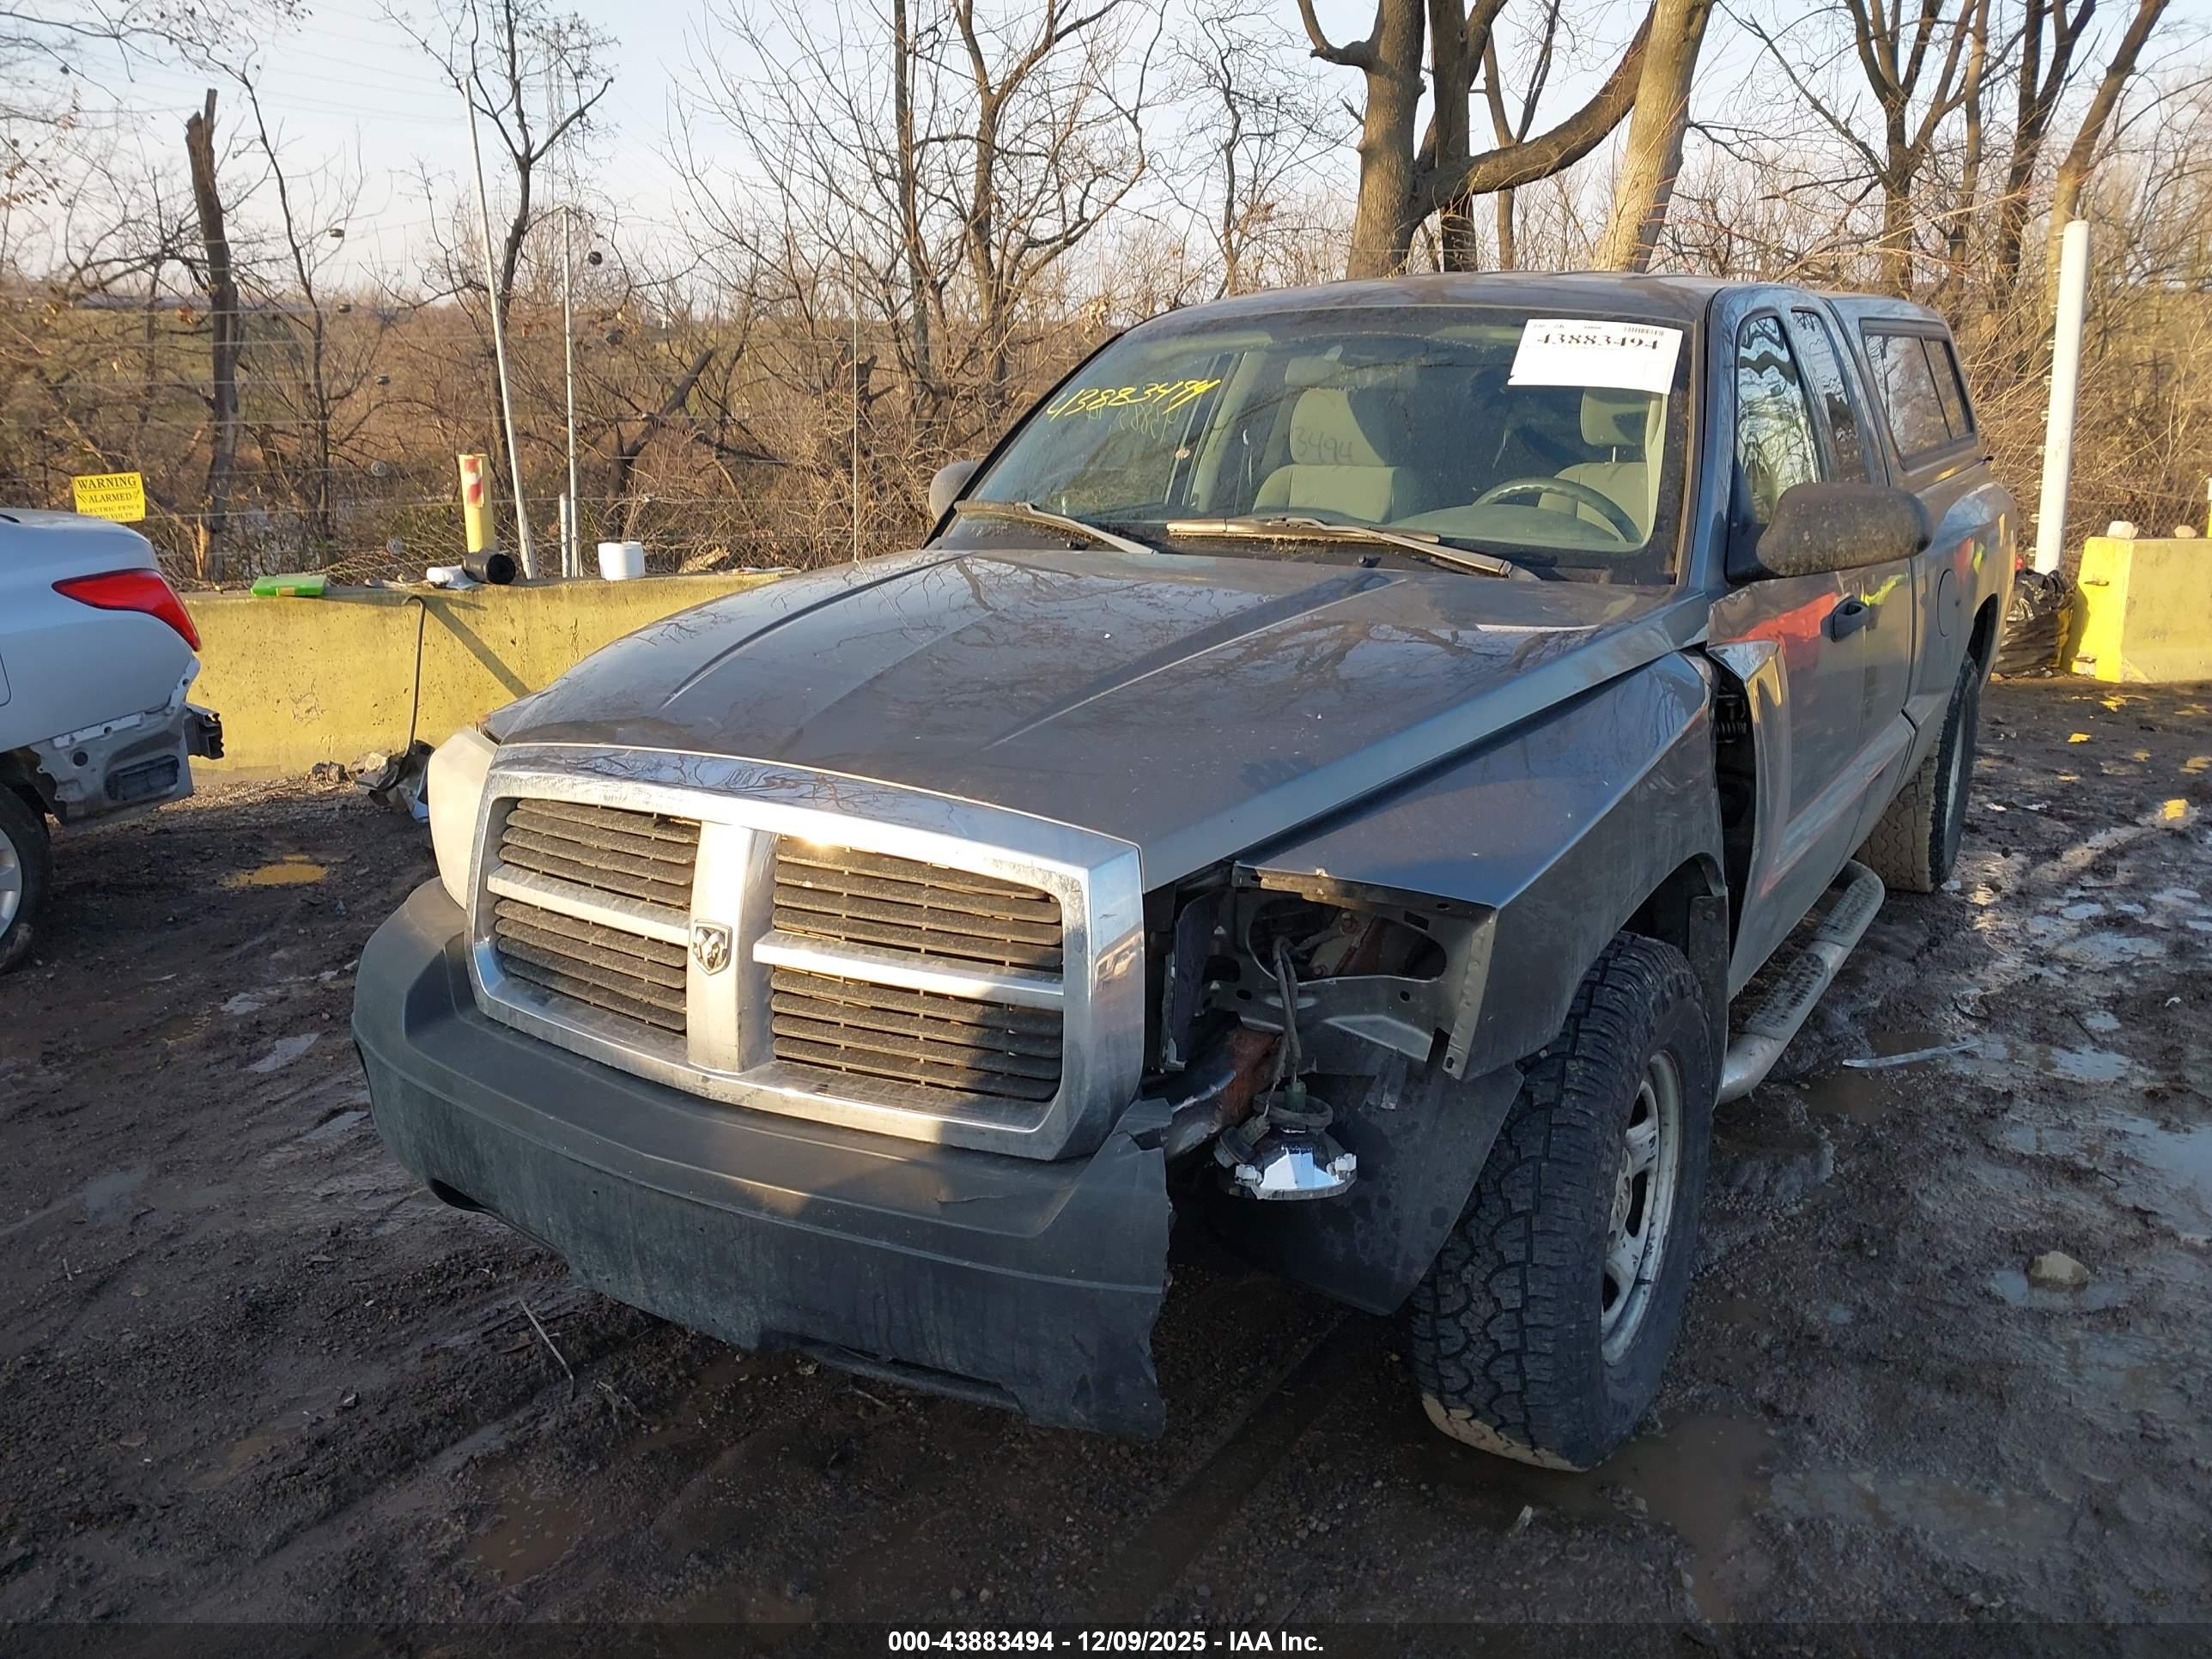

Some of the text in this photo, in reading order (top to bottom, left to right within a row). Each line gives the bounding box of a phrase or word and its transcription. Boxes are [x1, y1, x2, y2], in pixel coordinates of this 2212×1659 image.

[1537, 333, 1658, 349] 43883494
[1295, 427, 1355, 464] 3494
[76, 476, 137, 489] WARNING
[88, 493, 132, 503] ALARMED
